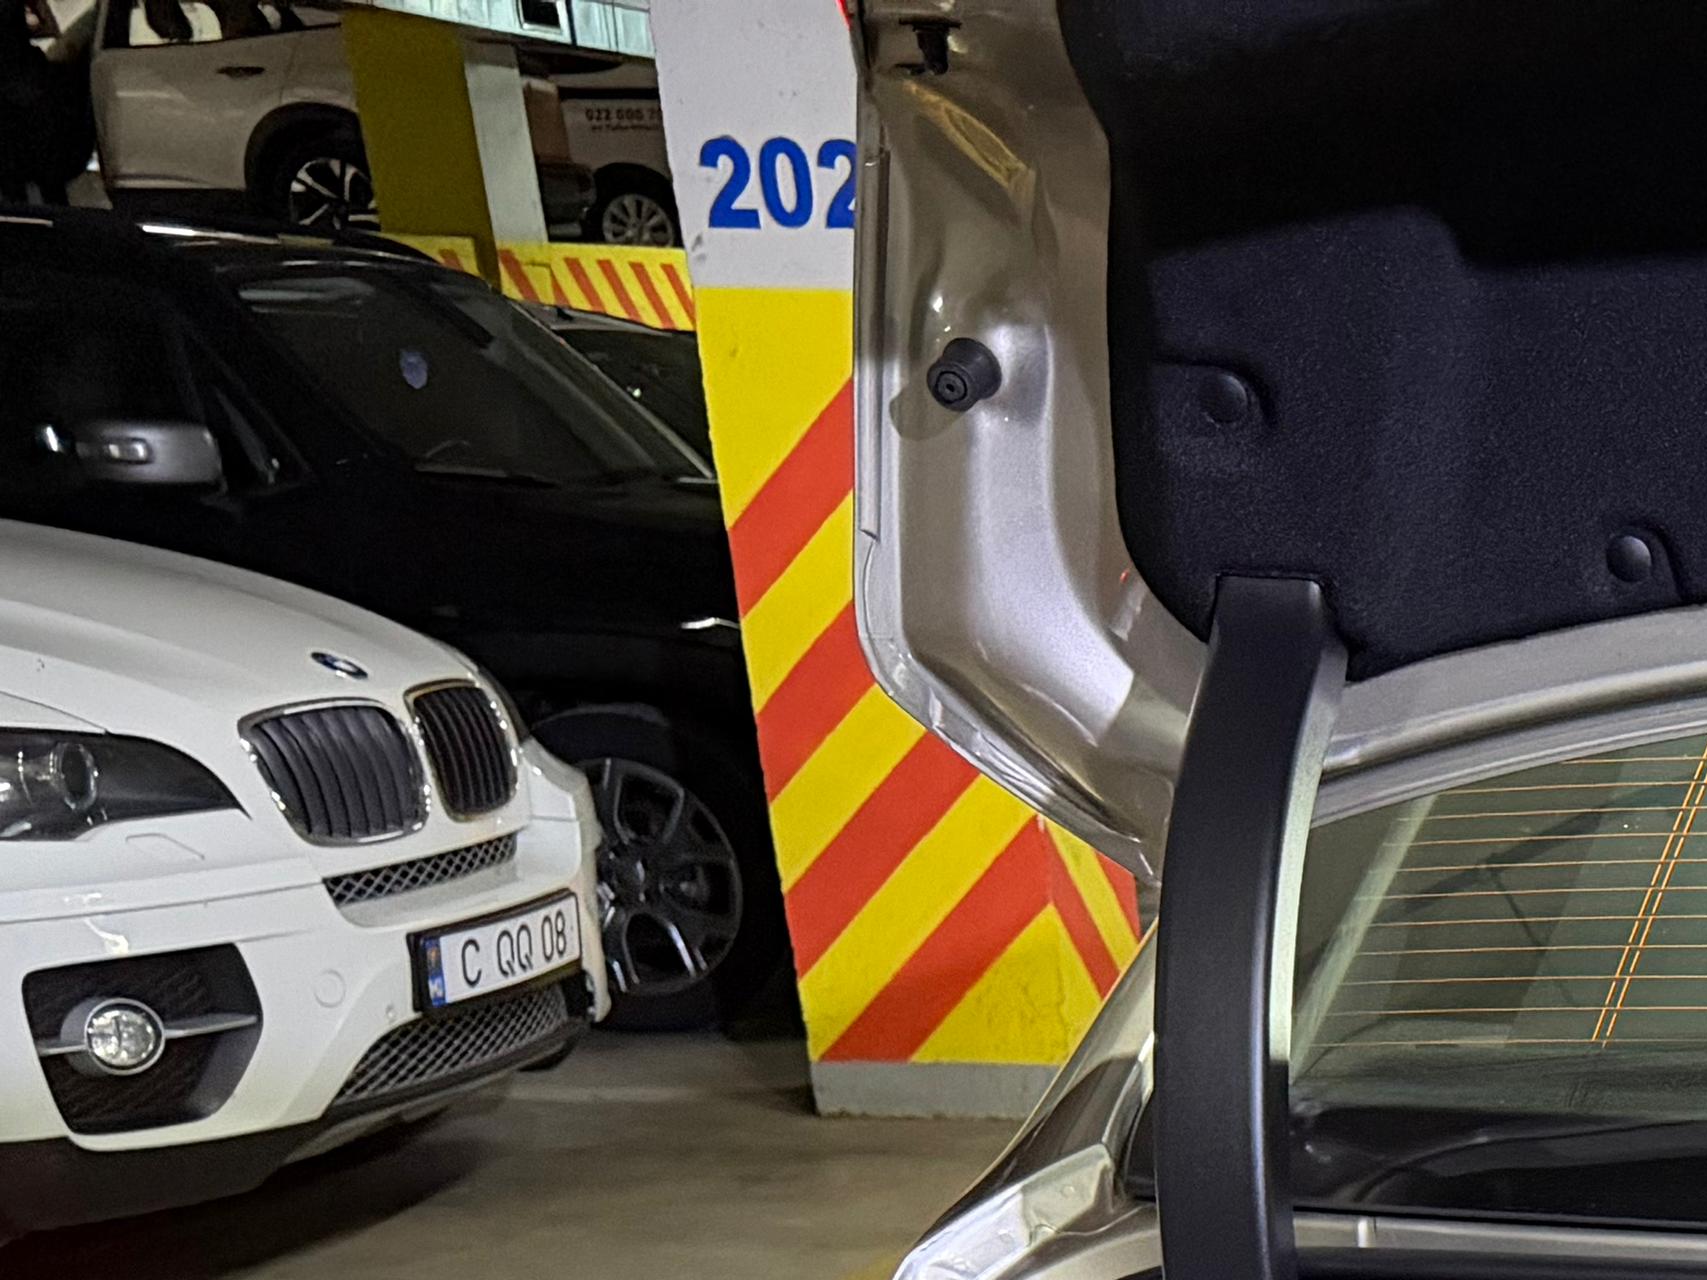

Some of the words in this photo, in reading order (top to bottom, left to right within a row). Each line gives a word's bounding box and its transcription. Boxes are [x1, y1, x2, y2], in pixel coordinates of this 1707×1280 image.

[698, 135, 857, 230] 202
[461, 938, 483, 988] C
[496, 923, 534, 977] QQ
[541, 909, 567, 962] 08
